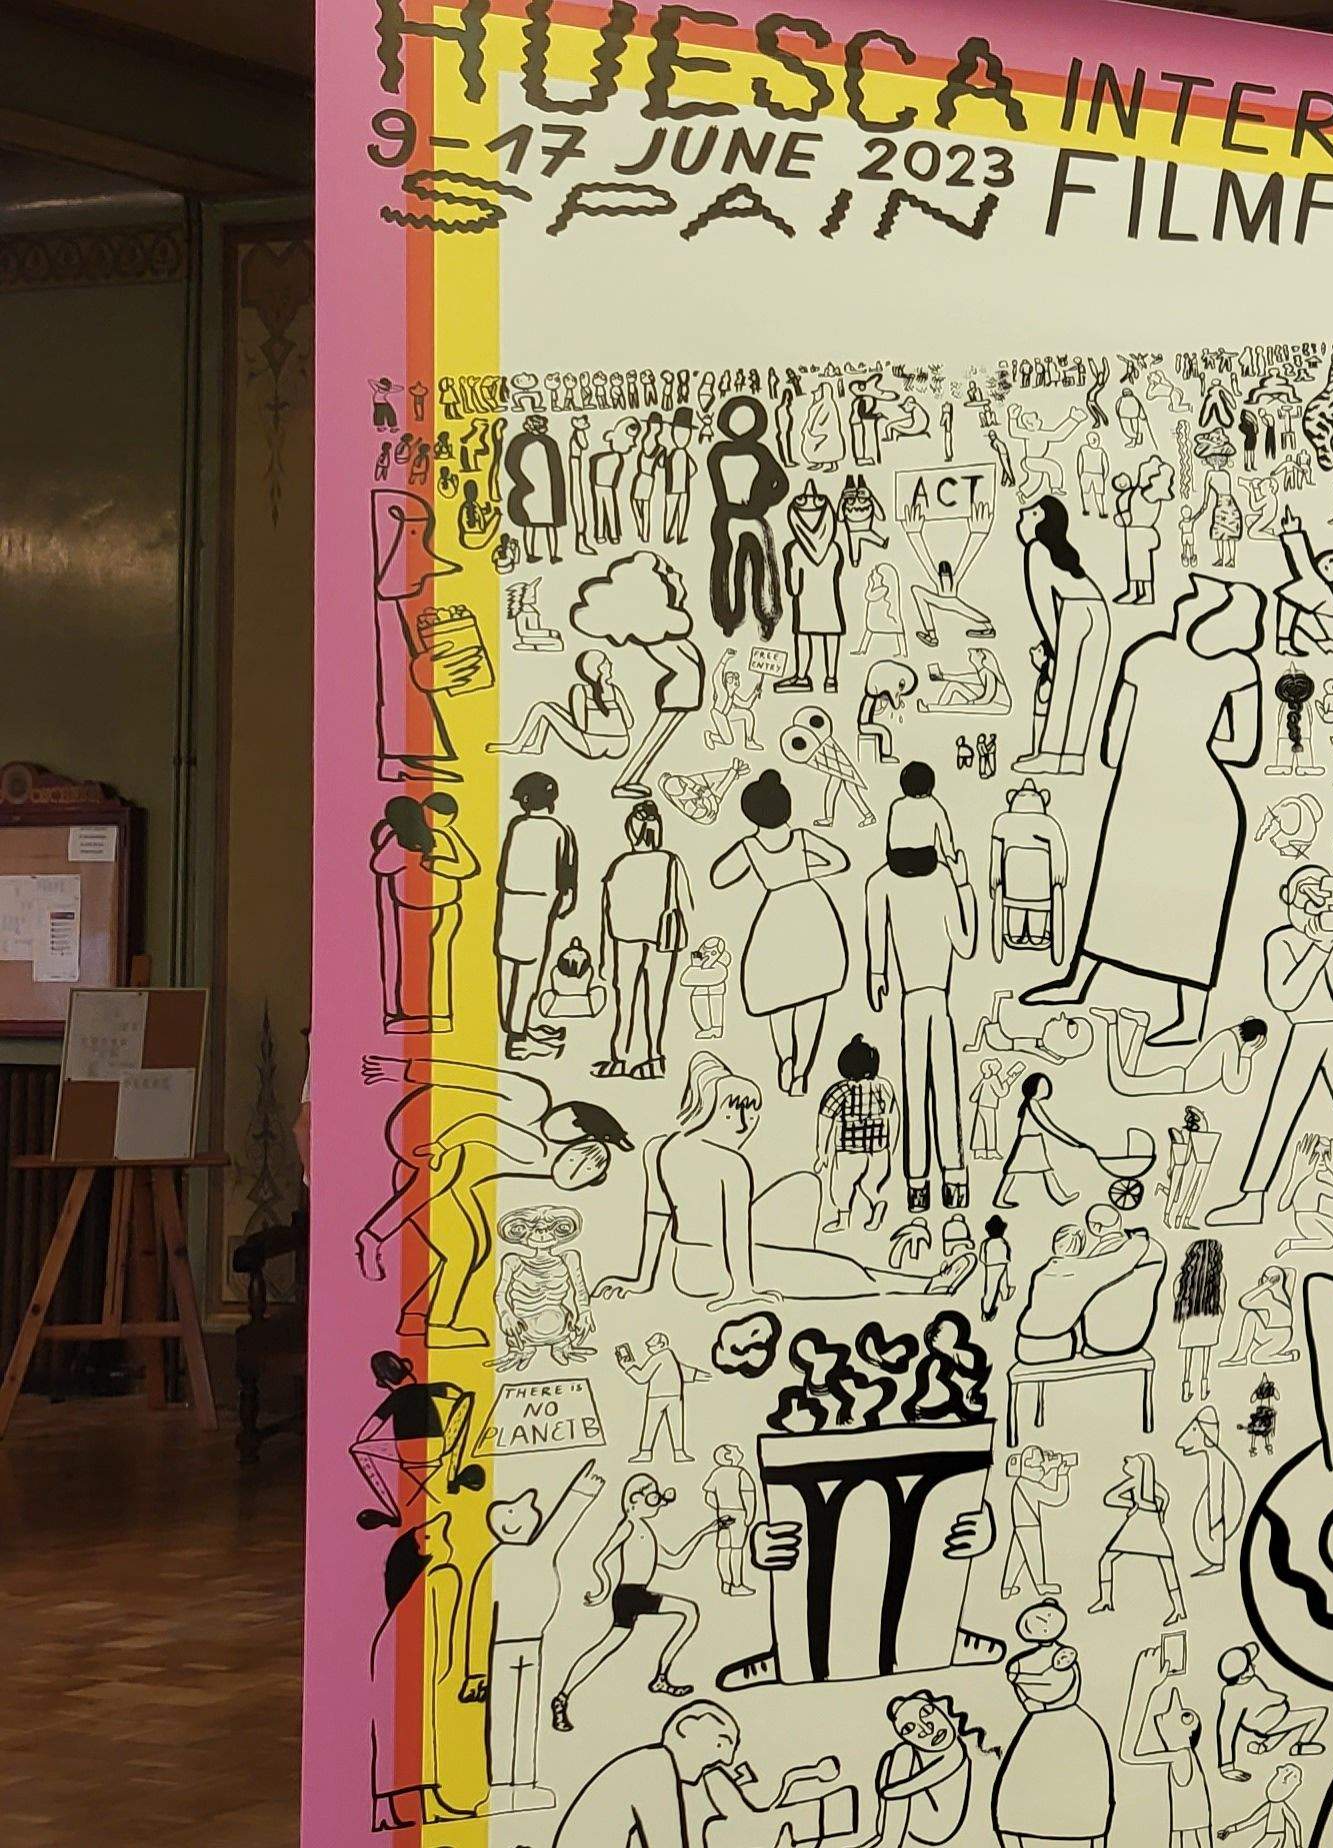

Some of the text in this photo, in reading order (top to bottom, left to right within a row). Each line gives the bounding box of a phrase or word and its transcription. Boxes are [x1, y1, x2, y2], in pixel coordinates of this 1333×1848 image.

[373, 0, 1028, 134] HUESCA
[614, 126, 822, 179] JUNE
[857, 138, 1015, 188] 2023
[380, 169, 998, 240] SPAIN
[911, 475, 985, 509] ACT
[751, 661, 781, 673] ENTRY
[753, 650, 779, 661] FREE
[505, 1384, 564, 1399] THERE
[523, 1400, 559, 1418] NO
[478, 1419, 575, 1449] PLANET
